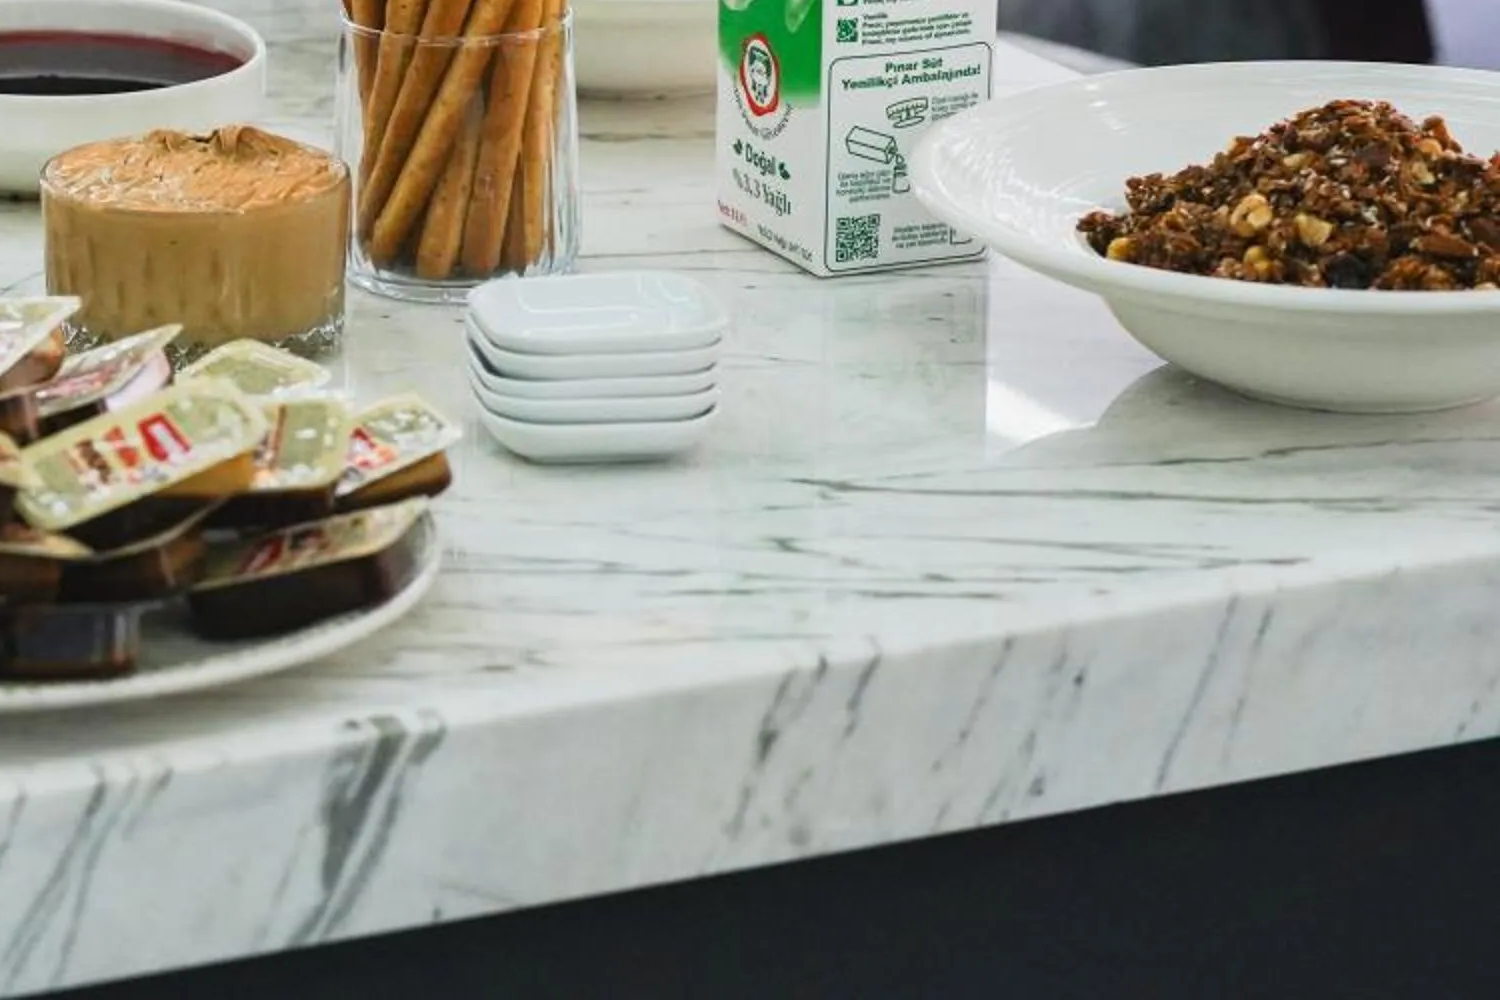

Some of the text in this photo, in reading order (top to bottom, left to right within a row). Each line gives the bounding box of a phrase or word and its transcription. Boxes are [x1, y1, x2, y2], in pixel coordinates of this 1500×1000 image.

[842, 64, 981, 90] Yenilikçi Ambalajında!
[885, 60, 919, 73] Pınar
[745, 143, 777, 176] Doğal
[762, 183, 791, 216] Yağlı
